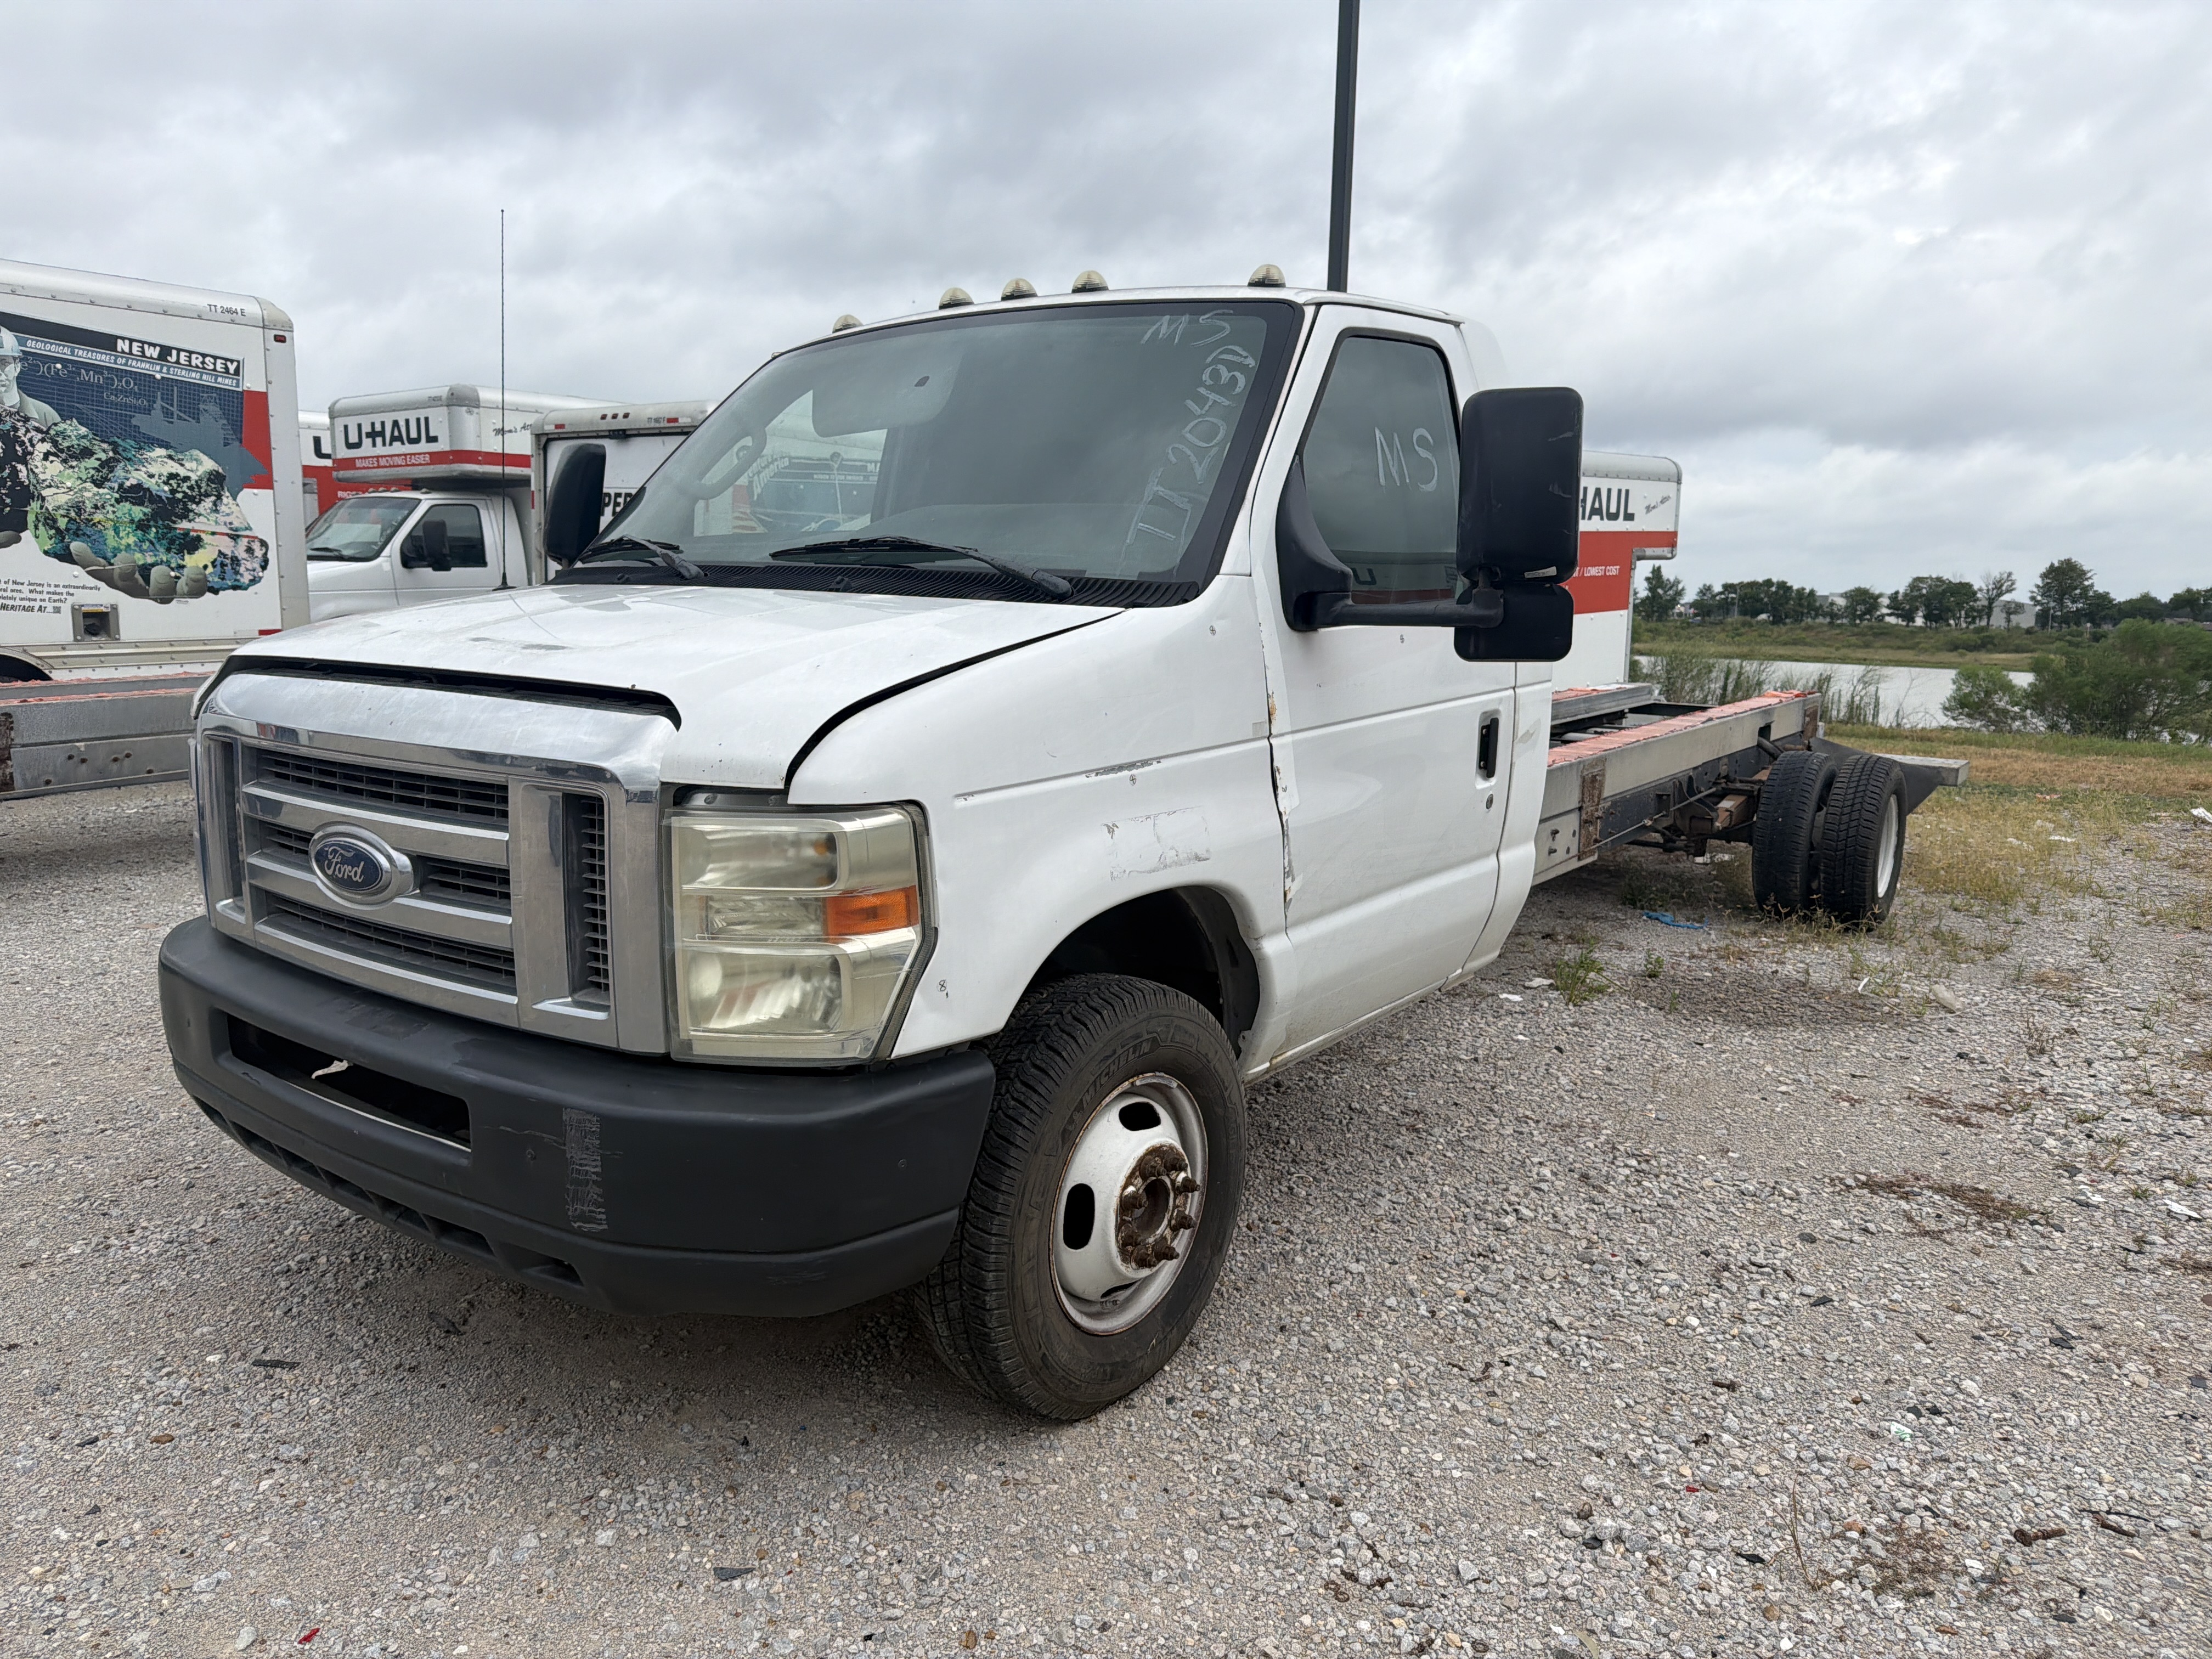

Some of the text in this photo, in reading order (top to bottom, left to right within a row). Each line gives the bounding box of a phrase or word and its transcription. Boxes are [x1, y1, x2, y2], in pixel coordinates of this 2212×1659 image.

[207, 303, 246, 317] TT 2464 E
[1141, 309, 1233, 347] MS
[26, 340, 71, 355] GEOLOGICAL
[74, 348, 115, 363] TREASURES
[117, 357, 126, 365] OF
[127, 359, 160, 371] FRANKLIN
[169, 368, 200, 379] STERLING
[202, 374, 216, 383] HILL
[217, 377, 237, 387] MINES
[116, 338, 238, 375] NEW JERSEY
[355, 454, 431, 468] MAKES MOVING EASIER
[1374, 427, 1438, 493] MS
[26, 579, 45, 589] Jersey
[62, 584, 101, 592] extraordinarily
[1584, 566, 1605, 577] LOWEST
[1606, 565, 1620, 575] COST
[324, 846, 366, 882] Ford
[1082, 1037, 1153, 1108] MICHELIN
